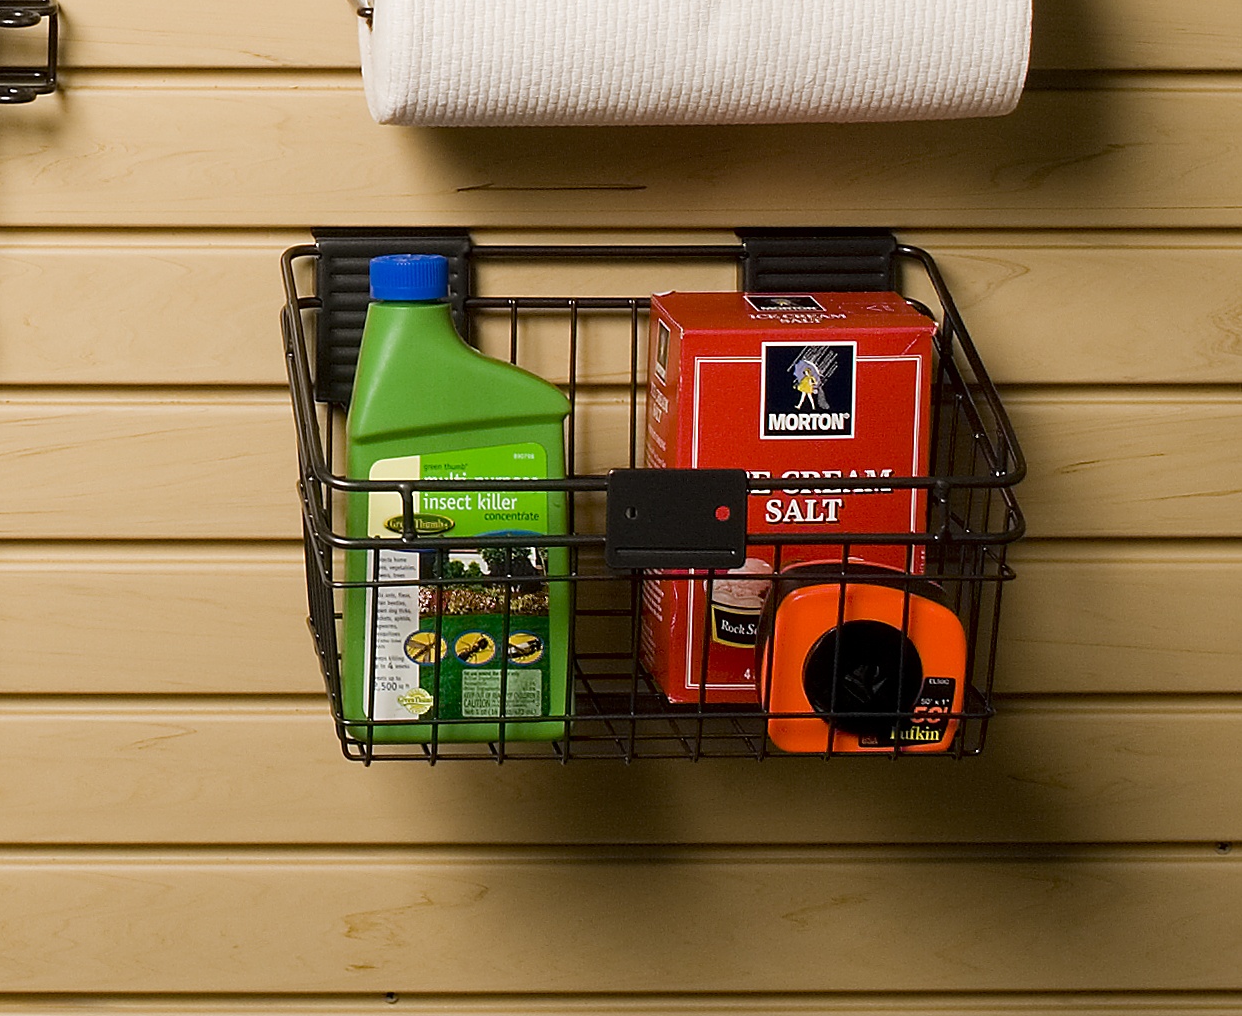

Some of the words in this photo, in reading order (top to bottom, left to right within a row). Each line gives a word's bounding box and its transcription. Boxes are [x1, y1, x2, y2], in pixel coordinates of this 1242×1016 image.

[768, 412, 845, 431] MORTON
[423, 492, 472, 510] insect
[477, 492, 518, 511] killer
[484, 511, 540, 521] concentrate
[765, 498, 843, 523] SALT
[721, 619, 745, 634] Rock
[463, 698, 490, 707] CAUTION
